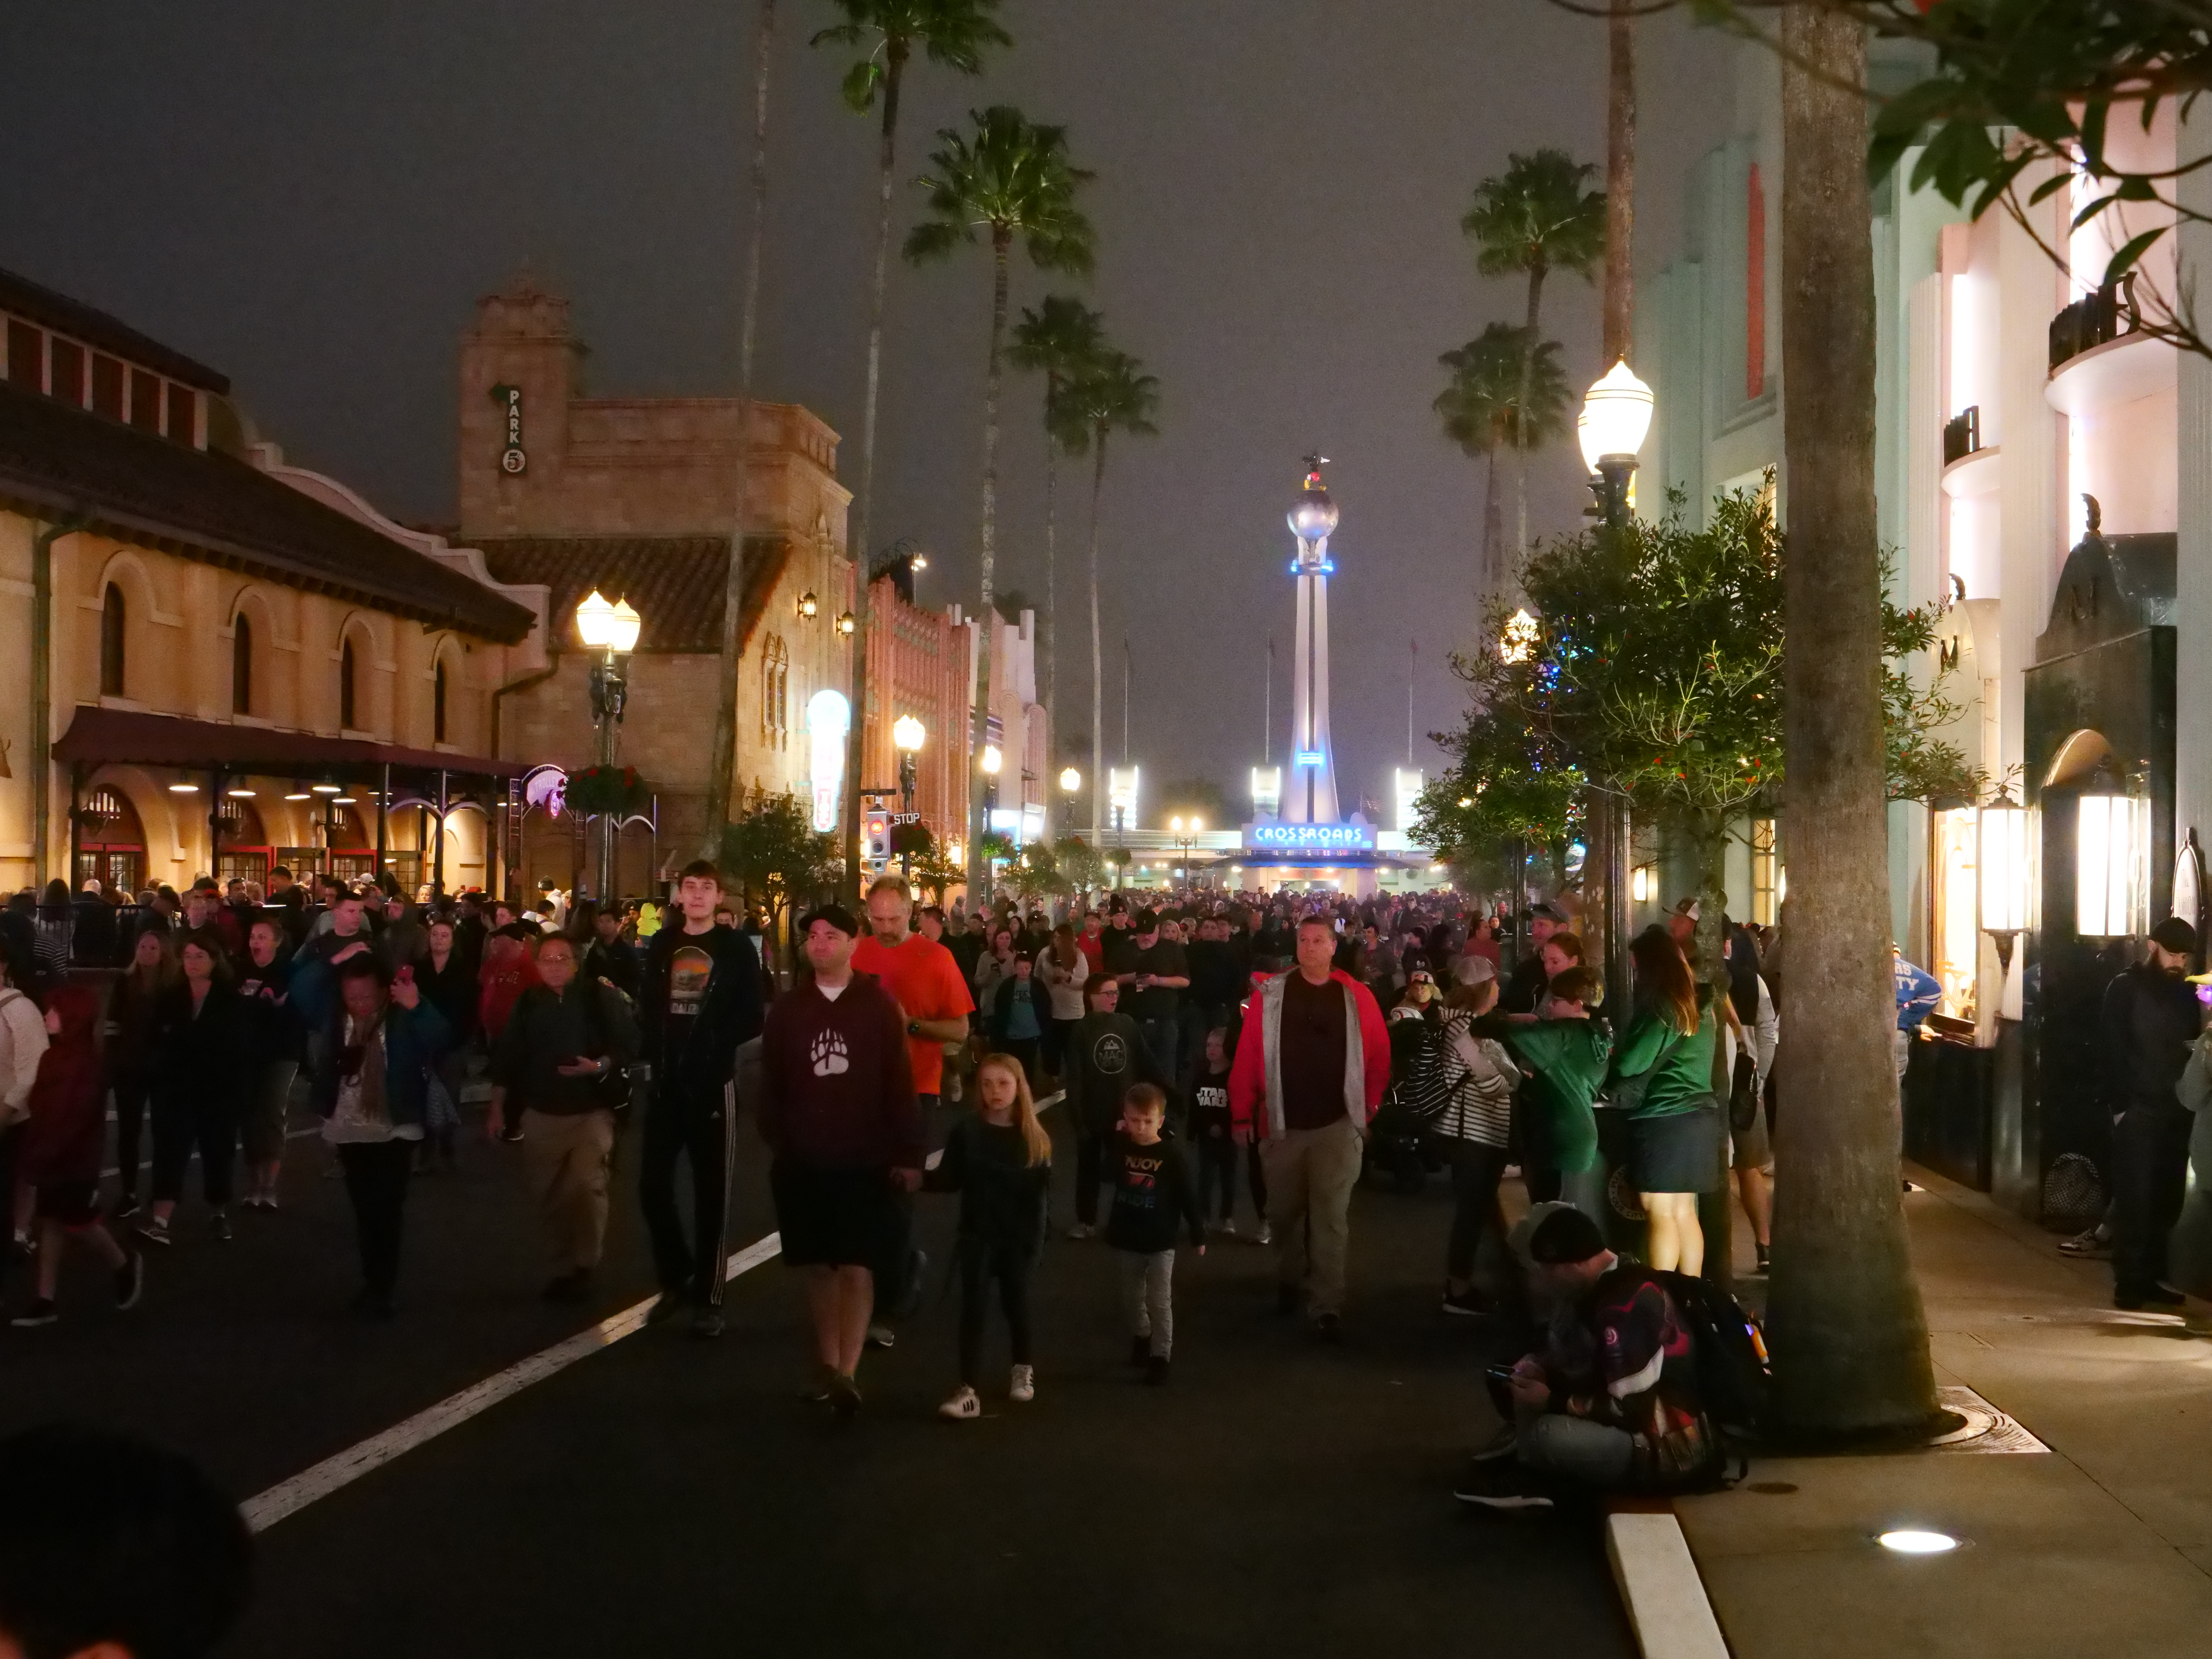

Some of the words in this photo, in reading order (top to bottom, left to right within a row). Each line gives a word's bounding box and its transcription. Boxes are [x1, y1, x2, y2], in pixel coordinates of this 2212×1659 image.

[509, 390, 520, 443] PARK
[507, 452, 520, 470] 5
[894, 812, 920, 825] STOP
[1256, 827, 1362, 841] CROSSROADS
[1895, 962, 1912, 976] RS
[1896, 975, 1919, 991] TY
[1196, 1087, 1228, 1098] STAR
[1125, 1155, 1163, 1172] NJOY
